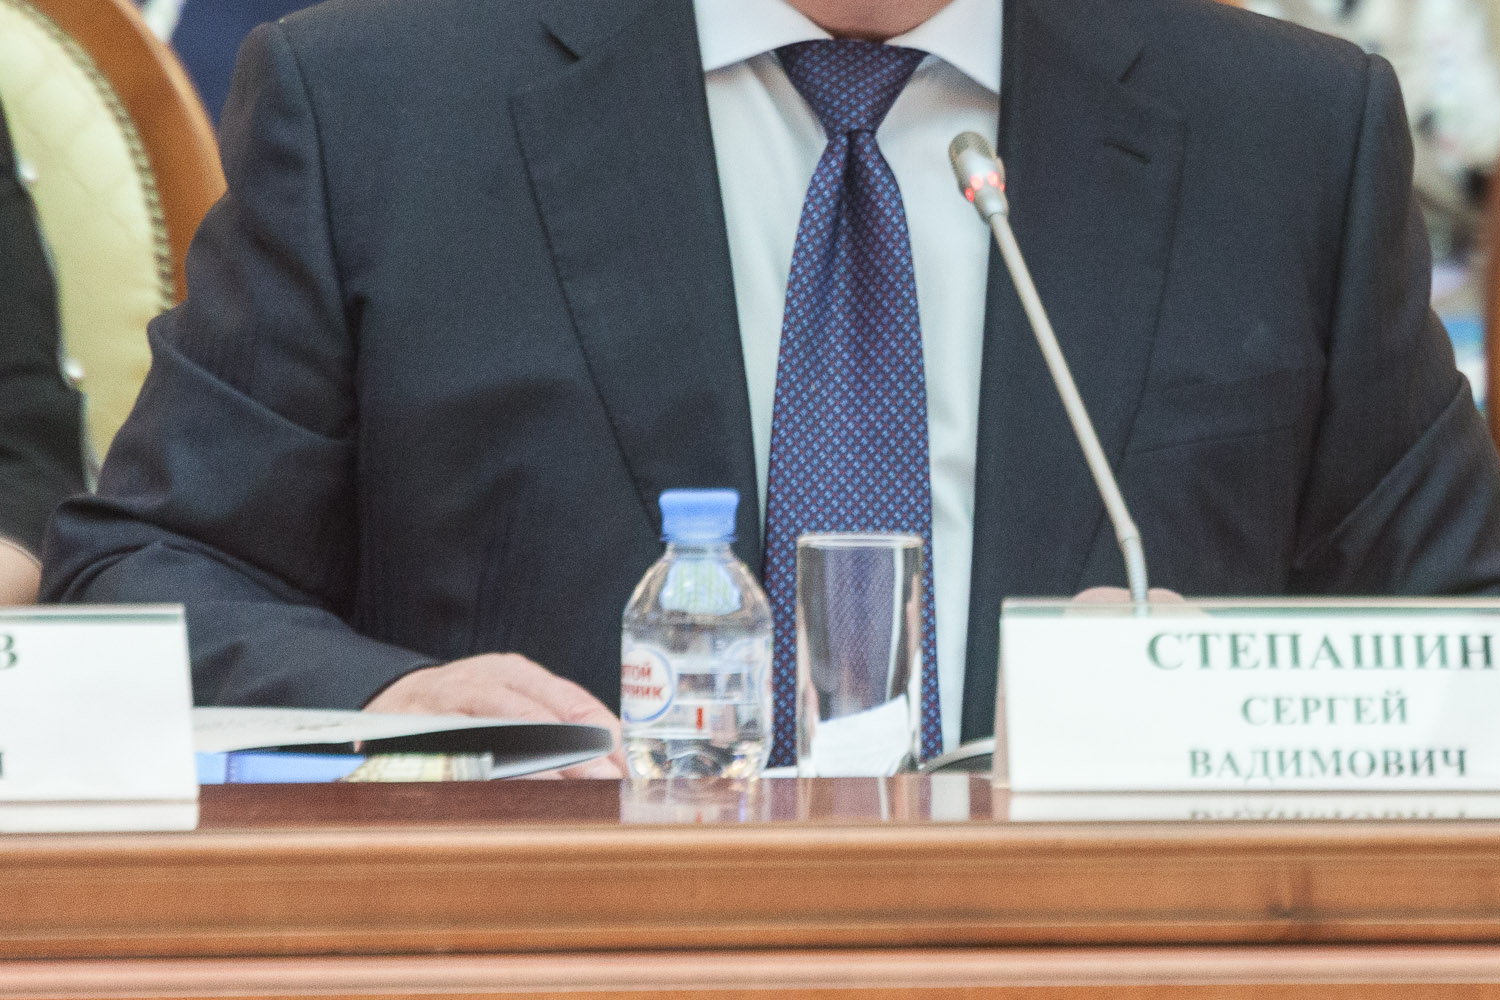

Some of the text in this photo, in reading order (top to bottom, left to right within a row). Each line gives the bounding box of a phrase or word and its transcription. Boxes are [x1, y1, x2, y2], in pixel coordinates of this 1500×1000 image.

[1146, 631, 1496, 671] СТЕПАШИН
[1240, 689, 1409, 726] СЕРГЕЙ
[1188, 748, 1469, 781] ВАДИМОВИЧ
